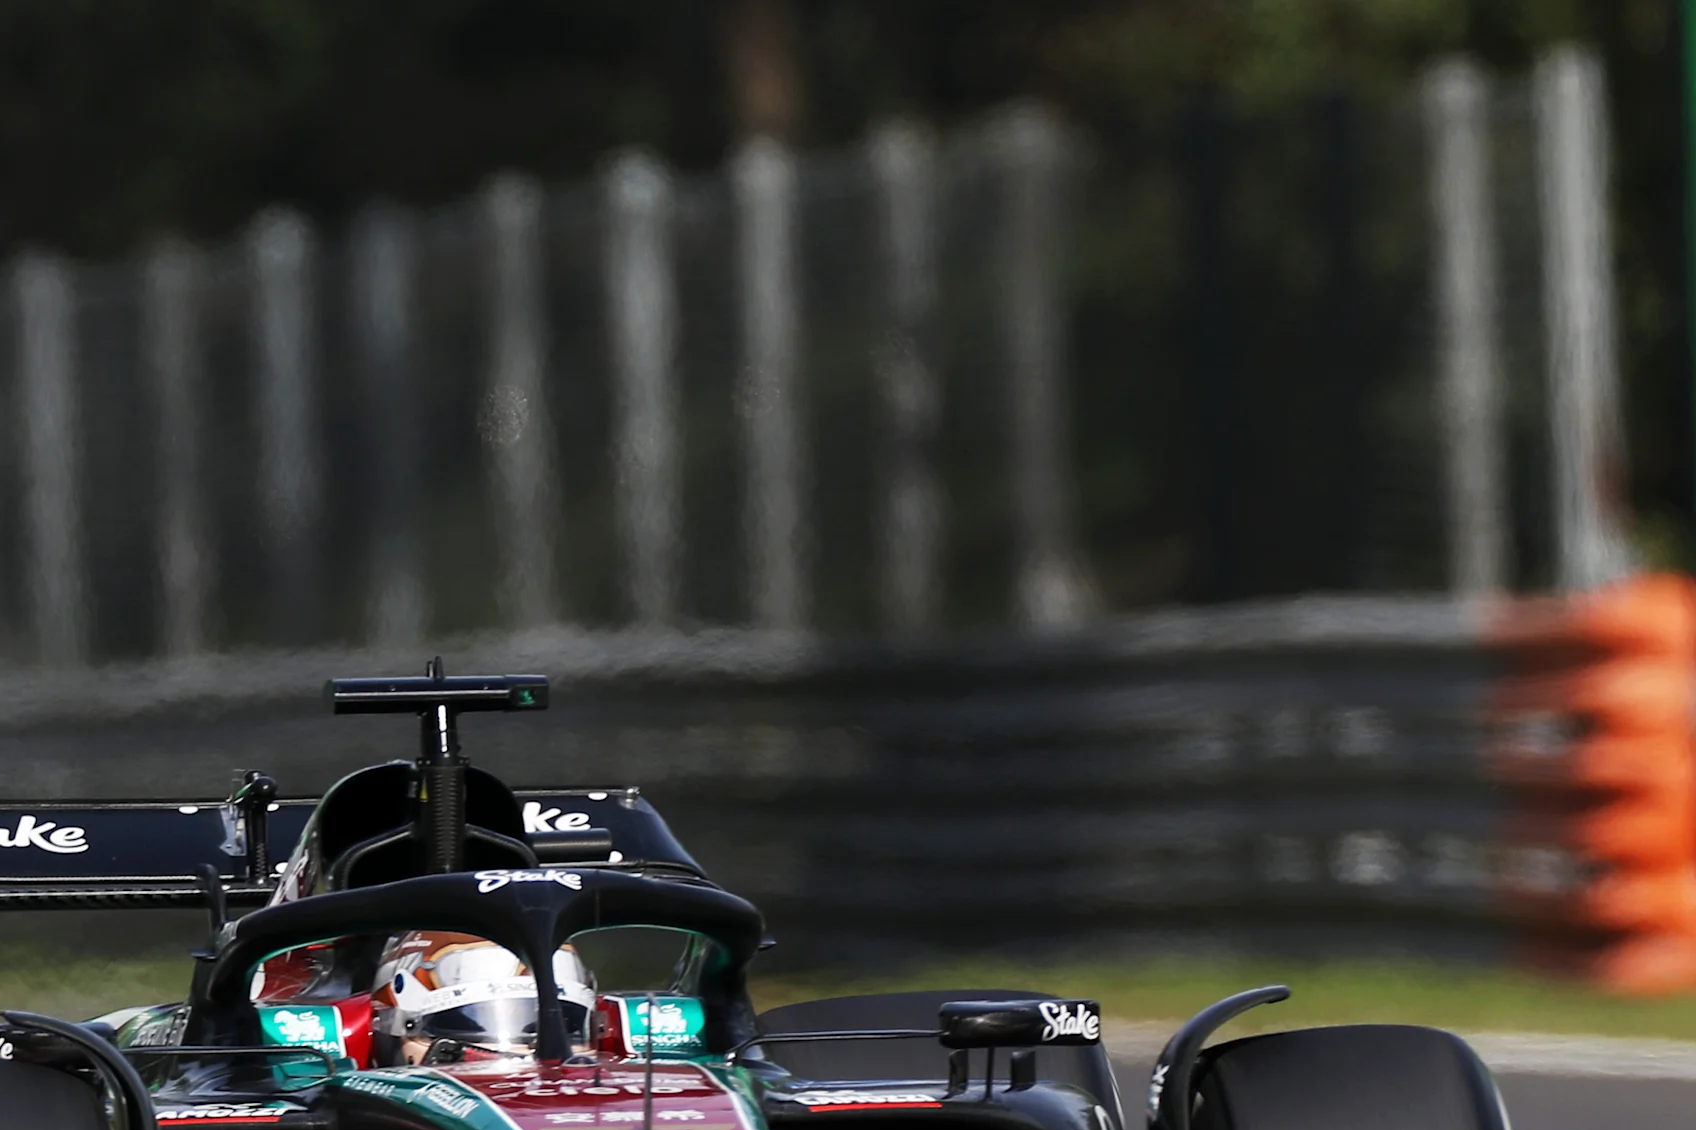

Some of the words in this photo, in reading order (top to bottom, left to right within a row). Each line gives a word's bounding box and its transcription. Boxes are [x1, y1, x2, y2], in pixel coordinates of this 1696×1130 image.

[474, 869, 583, 893] Stake
[1039, 1003, 1100, 1041] Stake
[156, 1106, 287, 1120] AMOZZI
